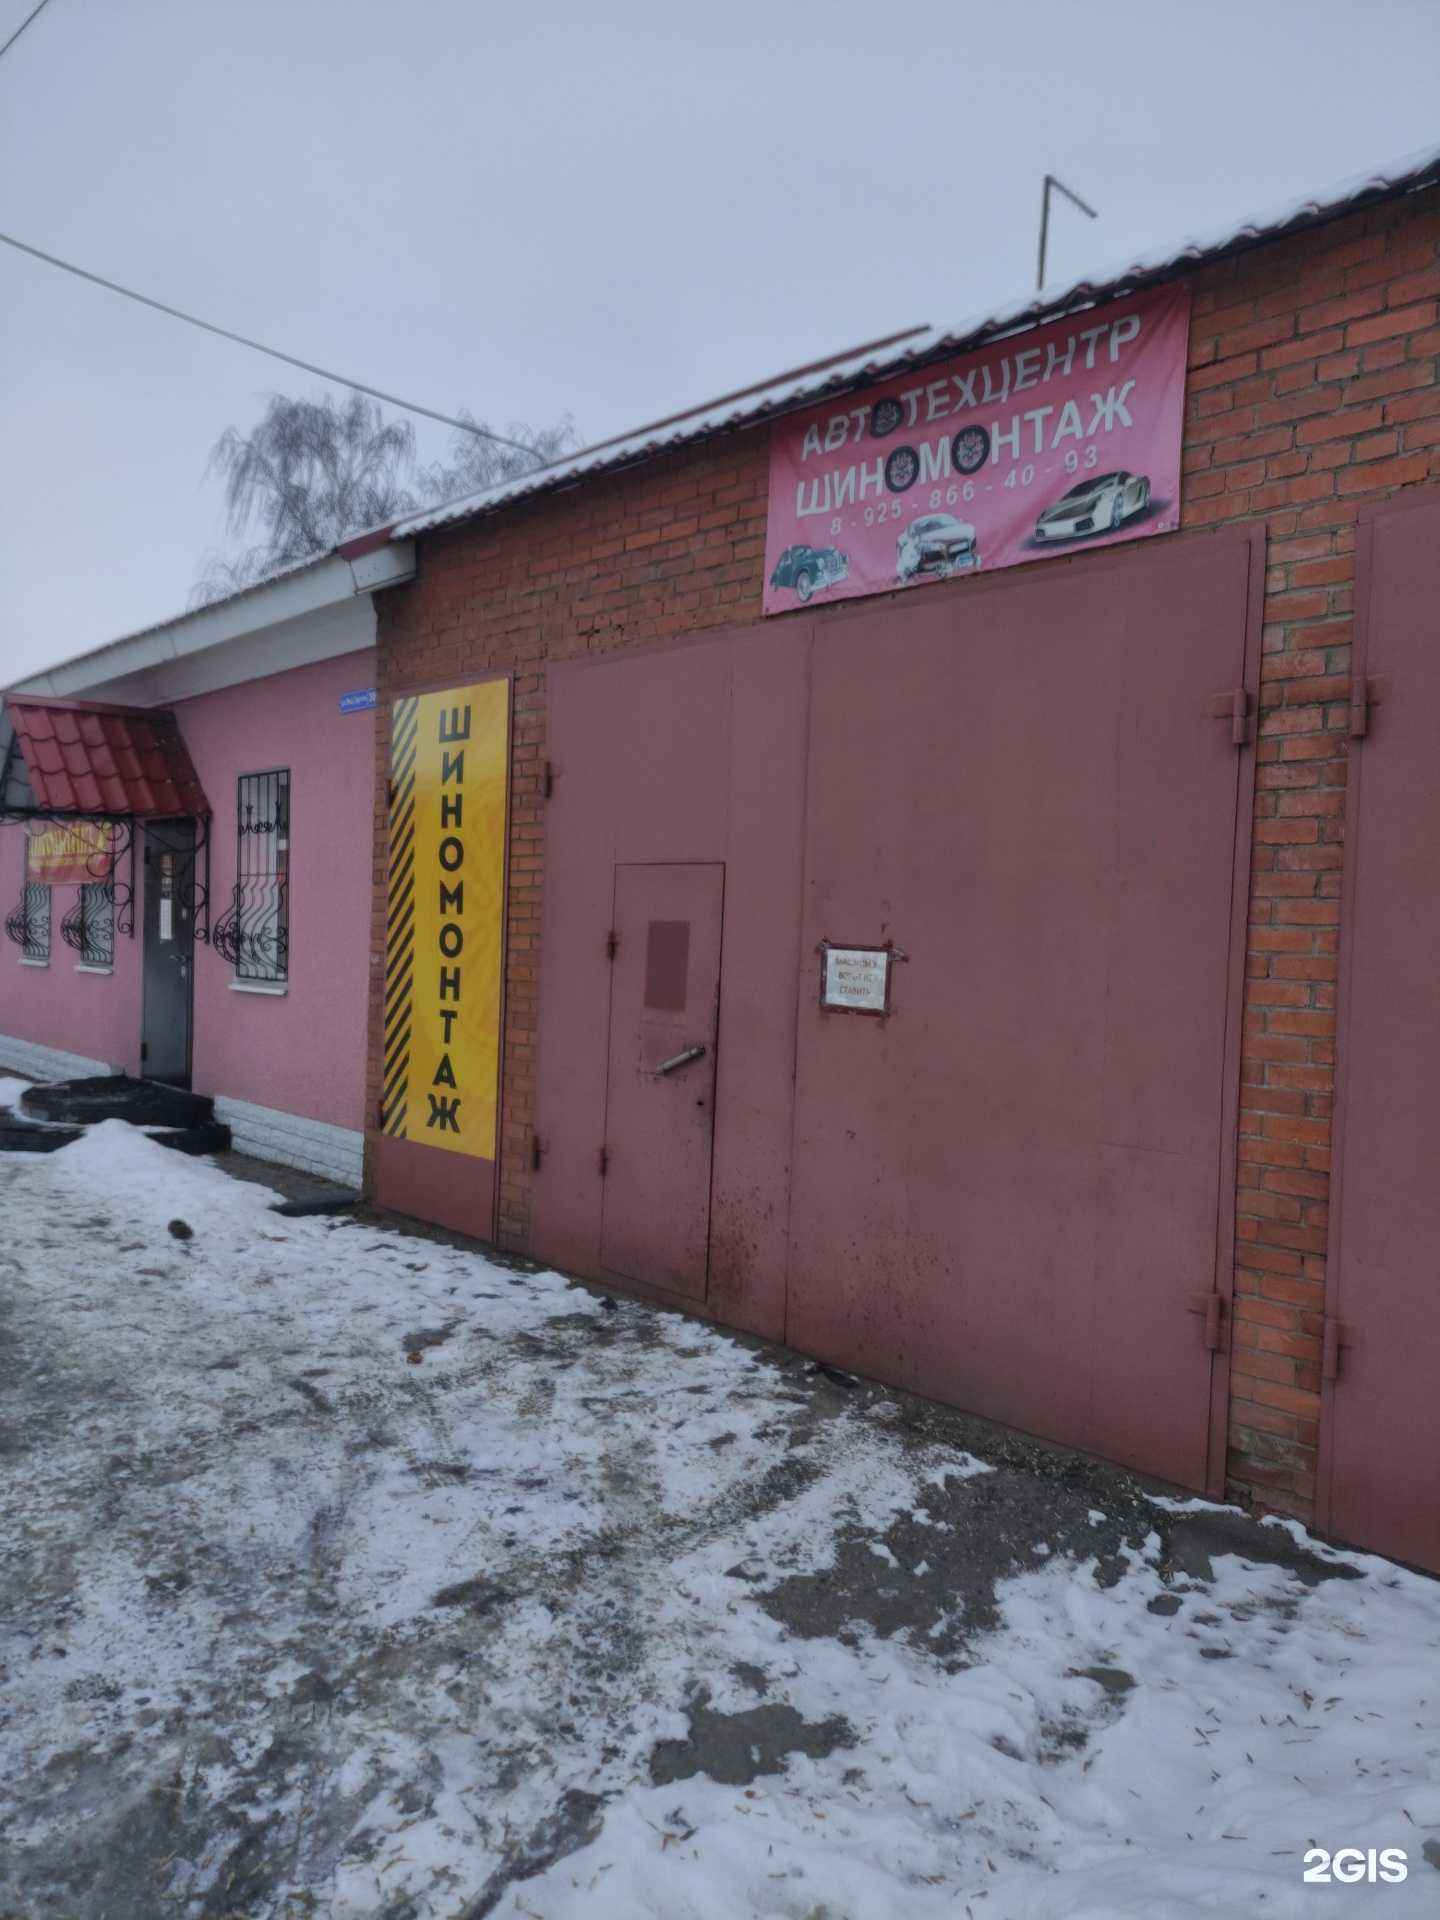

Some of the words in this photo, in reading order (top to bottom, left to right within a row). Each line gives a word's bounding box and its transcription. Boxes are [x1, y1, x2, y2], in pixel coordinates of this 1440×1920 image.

[796, 379, 1136, 519] ШИНОМОНТАЖ
[802, 313, 1141, 462] АВТОТЕХЦЕНТР
[426, 704, 472, 1134] ШИНОМОНТАЖ
